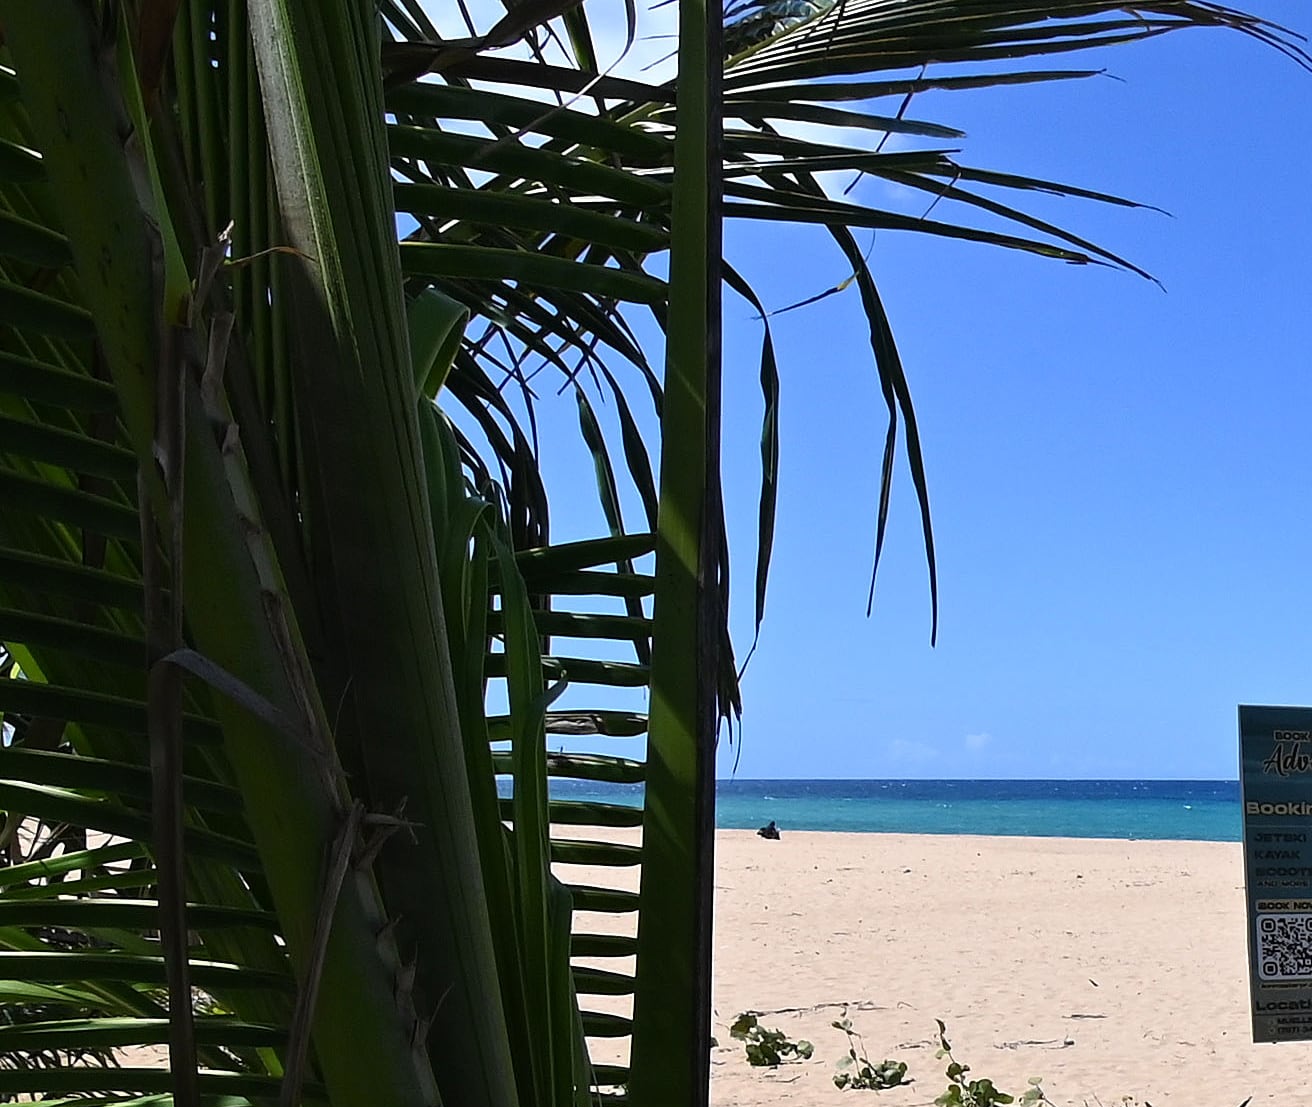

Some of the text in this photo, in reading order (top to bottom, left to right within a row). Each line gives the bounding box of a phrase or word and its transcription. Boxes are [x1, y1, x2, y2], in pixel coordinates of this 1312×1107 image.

[1274, 730, 1310, 742] BOOK
[1254, 850, 1301, 859] KAYAK
[1257, 901, 1290, 910] BOOK
